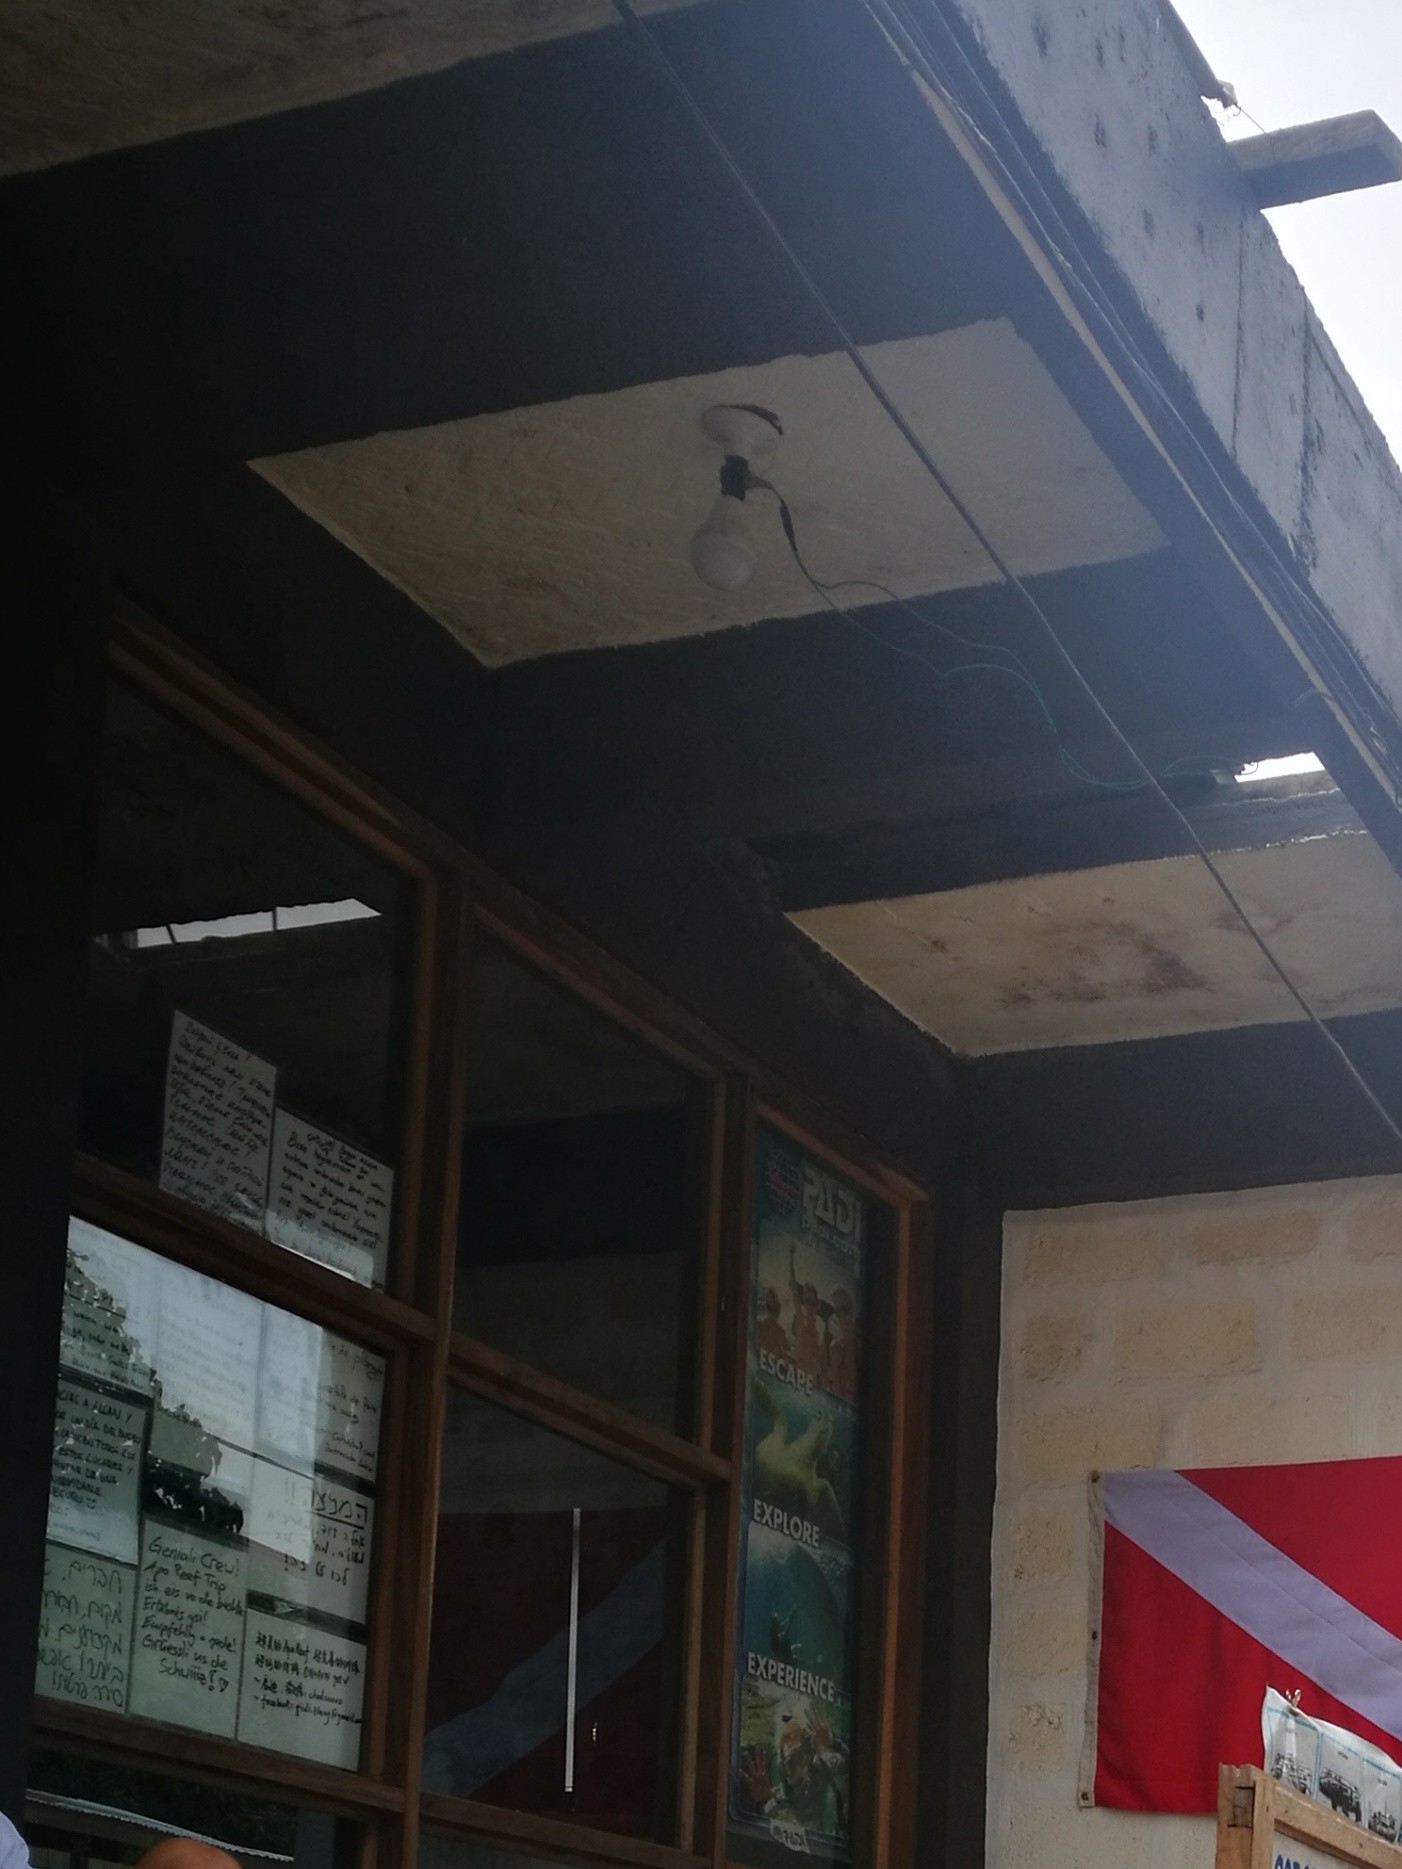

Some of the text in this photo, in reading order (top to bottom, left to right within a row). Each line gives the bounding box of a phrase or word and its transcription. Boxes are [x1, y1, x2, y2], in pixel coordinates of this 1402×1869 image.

[803, 1163, 861, 1242] PADI
[760, 1351, 814, 1396] ESCAPE
[753, 1499, 819, 1547] EXPLORE
[748, 1651, 834, 1702] EXPERIENCE
